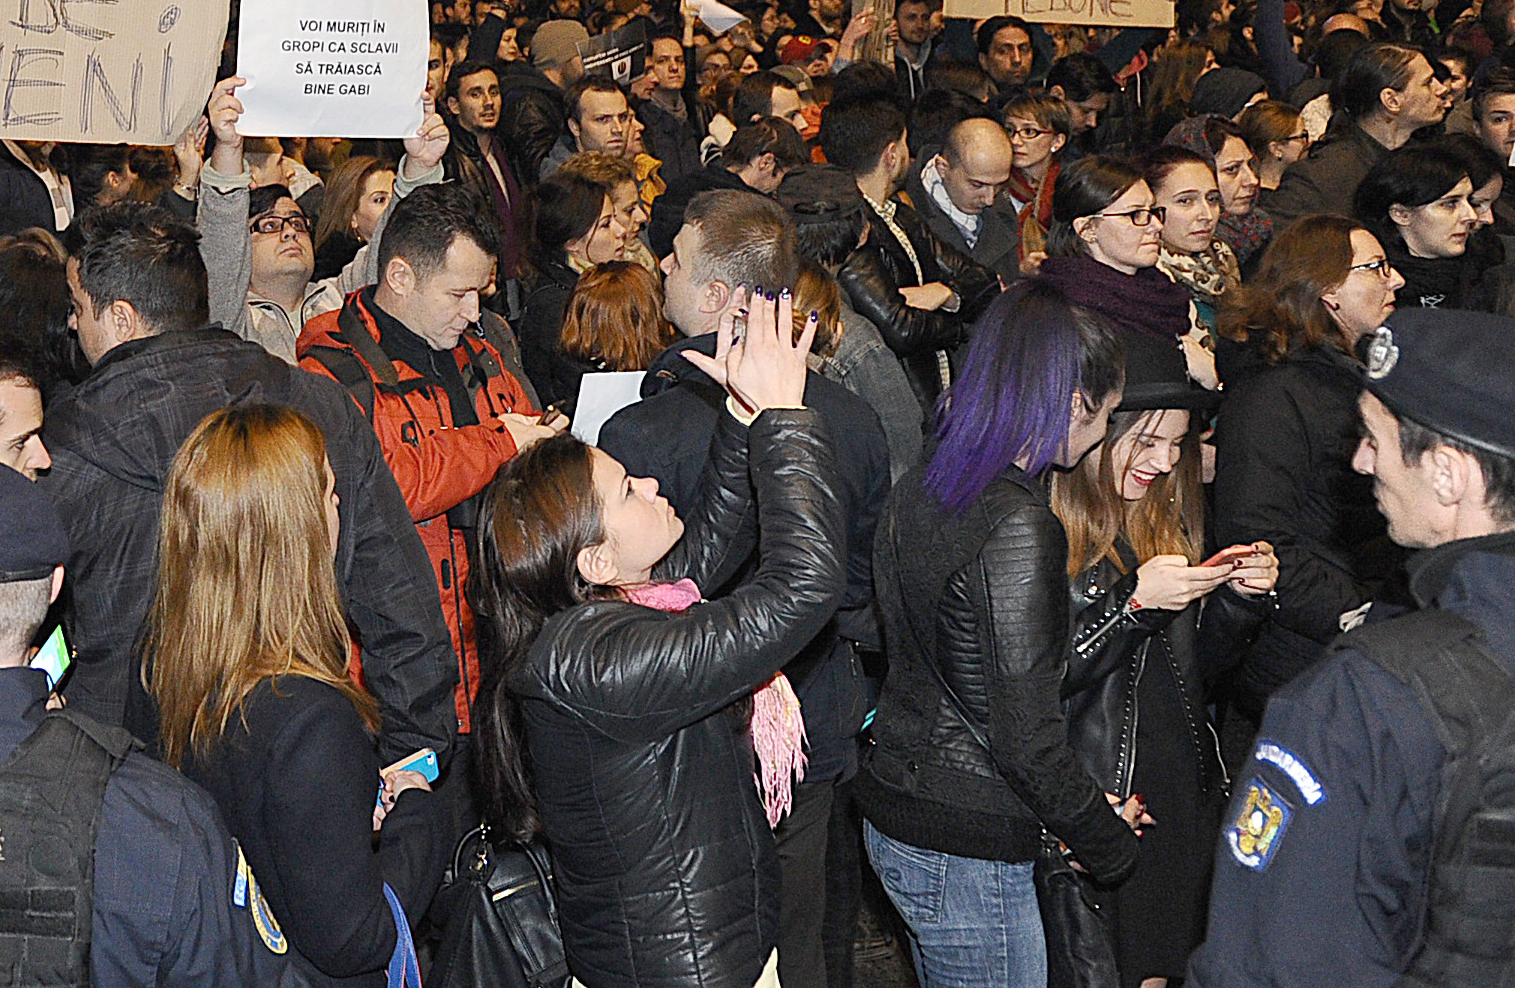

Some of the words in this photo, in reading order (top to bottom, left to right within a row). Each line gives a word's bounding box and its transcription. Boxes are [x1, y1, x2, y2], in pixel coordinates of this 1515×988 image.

[299, 20, 322, 32] VOI
[373, 19, 386, 33] ÎN
[281, 40, 324, 53] GROPI
[328, 42, 347, 53] CA
[350, 42, 399, 54] SCLAVII
[295, 61, 314, 74] SĂ
[318, 62, 382, 76] TRĂIASCĂ
[304, 83, 335, 95] BINE
[338, 84, 370, 95] GABI
